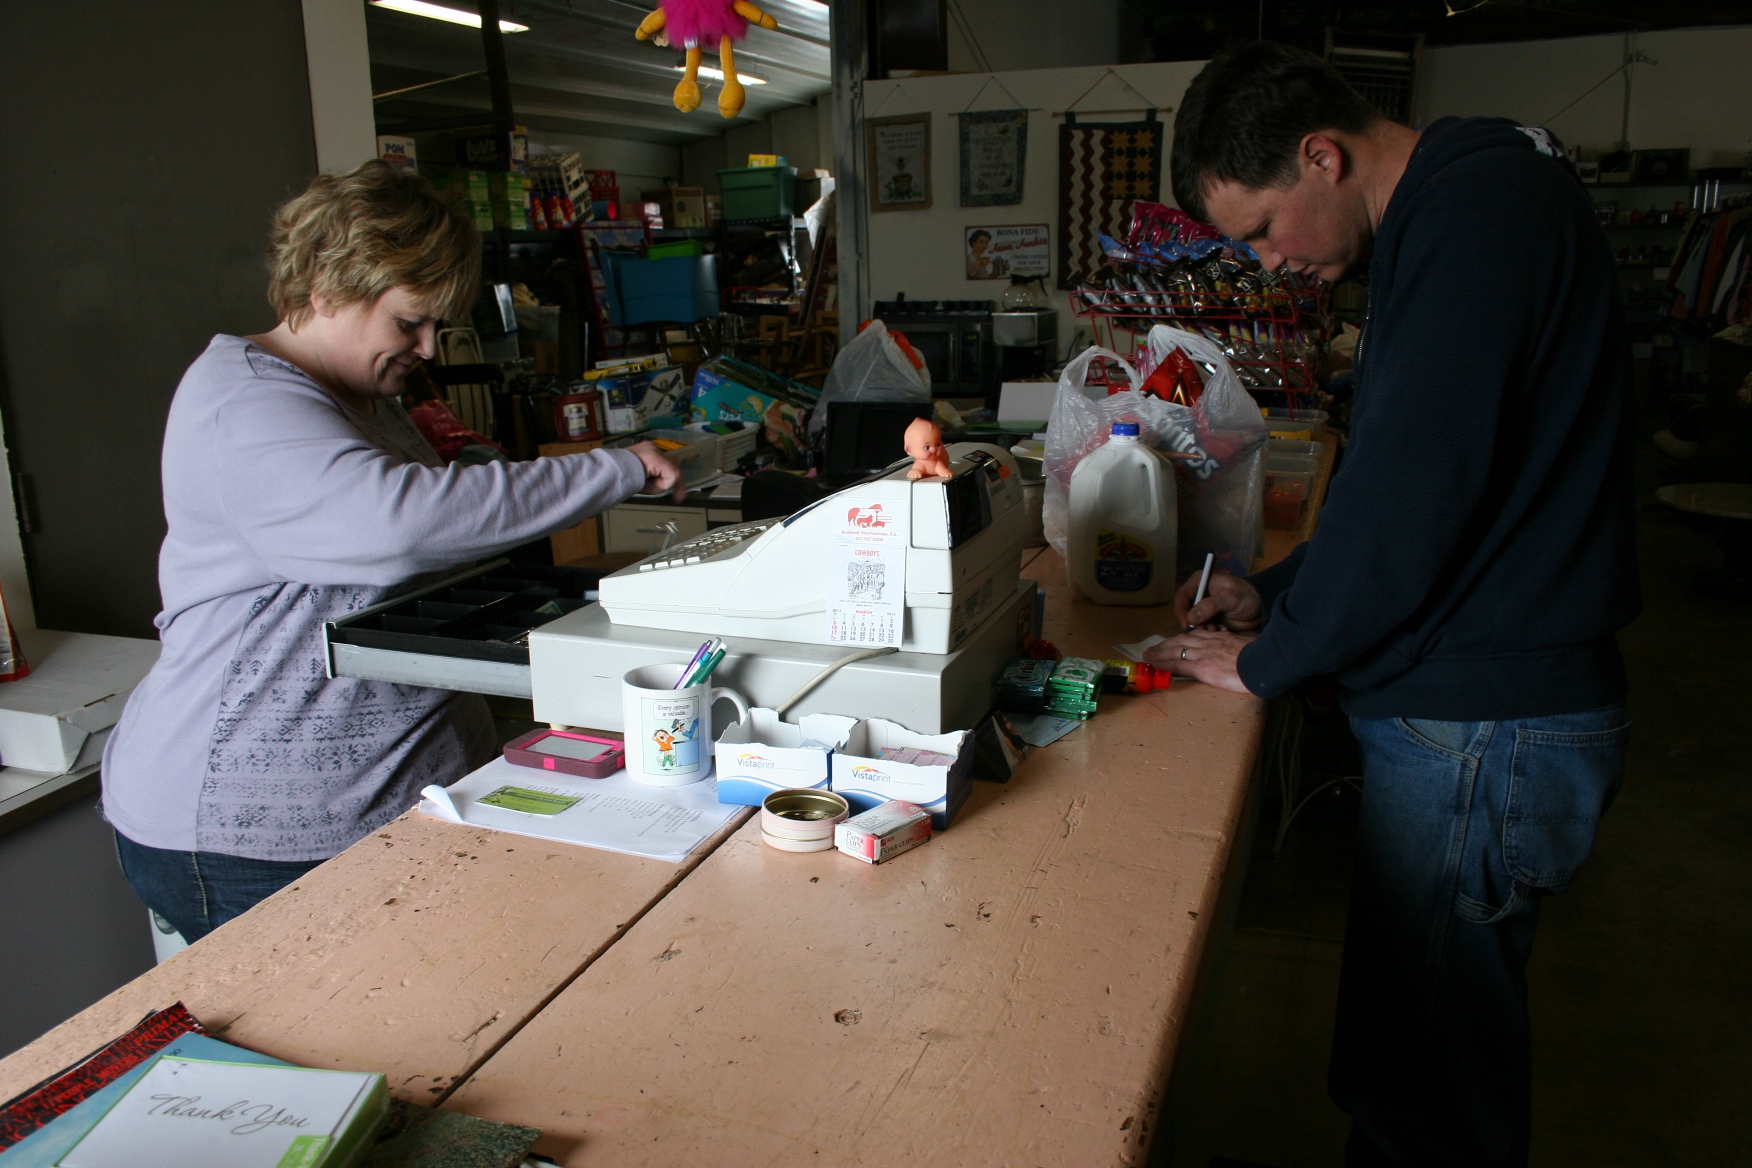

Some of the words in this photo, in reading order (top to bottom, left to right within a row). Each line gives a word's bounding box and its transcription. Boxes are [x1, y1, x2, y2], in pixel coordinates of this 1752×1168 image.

[385, 143, 405, 154] POM
[989, 242, 1013, 254] Java
[737, 758, 775, 770] Vistaprint
[852, 769, 891, 783] Vistaprint
[846, 830, 864, 844] PAPER
[846, 839, 861, 848] CLIPS
[880, 845, 898, 856] PAPER
[899, 837, 914, 848] CLIPS
[148, 1094, 250, 1121] Thank
[231, 1104, 312, 1135] You
